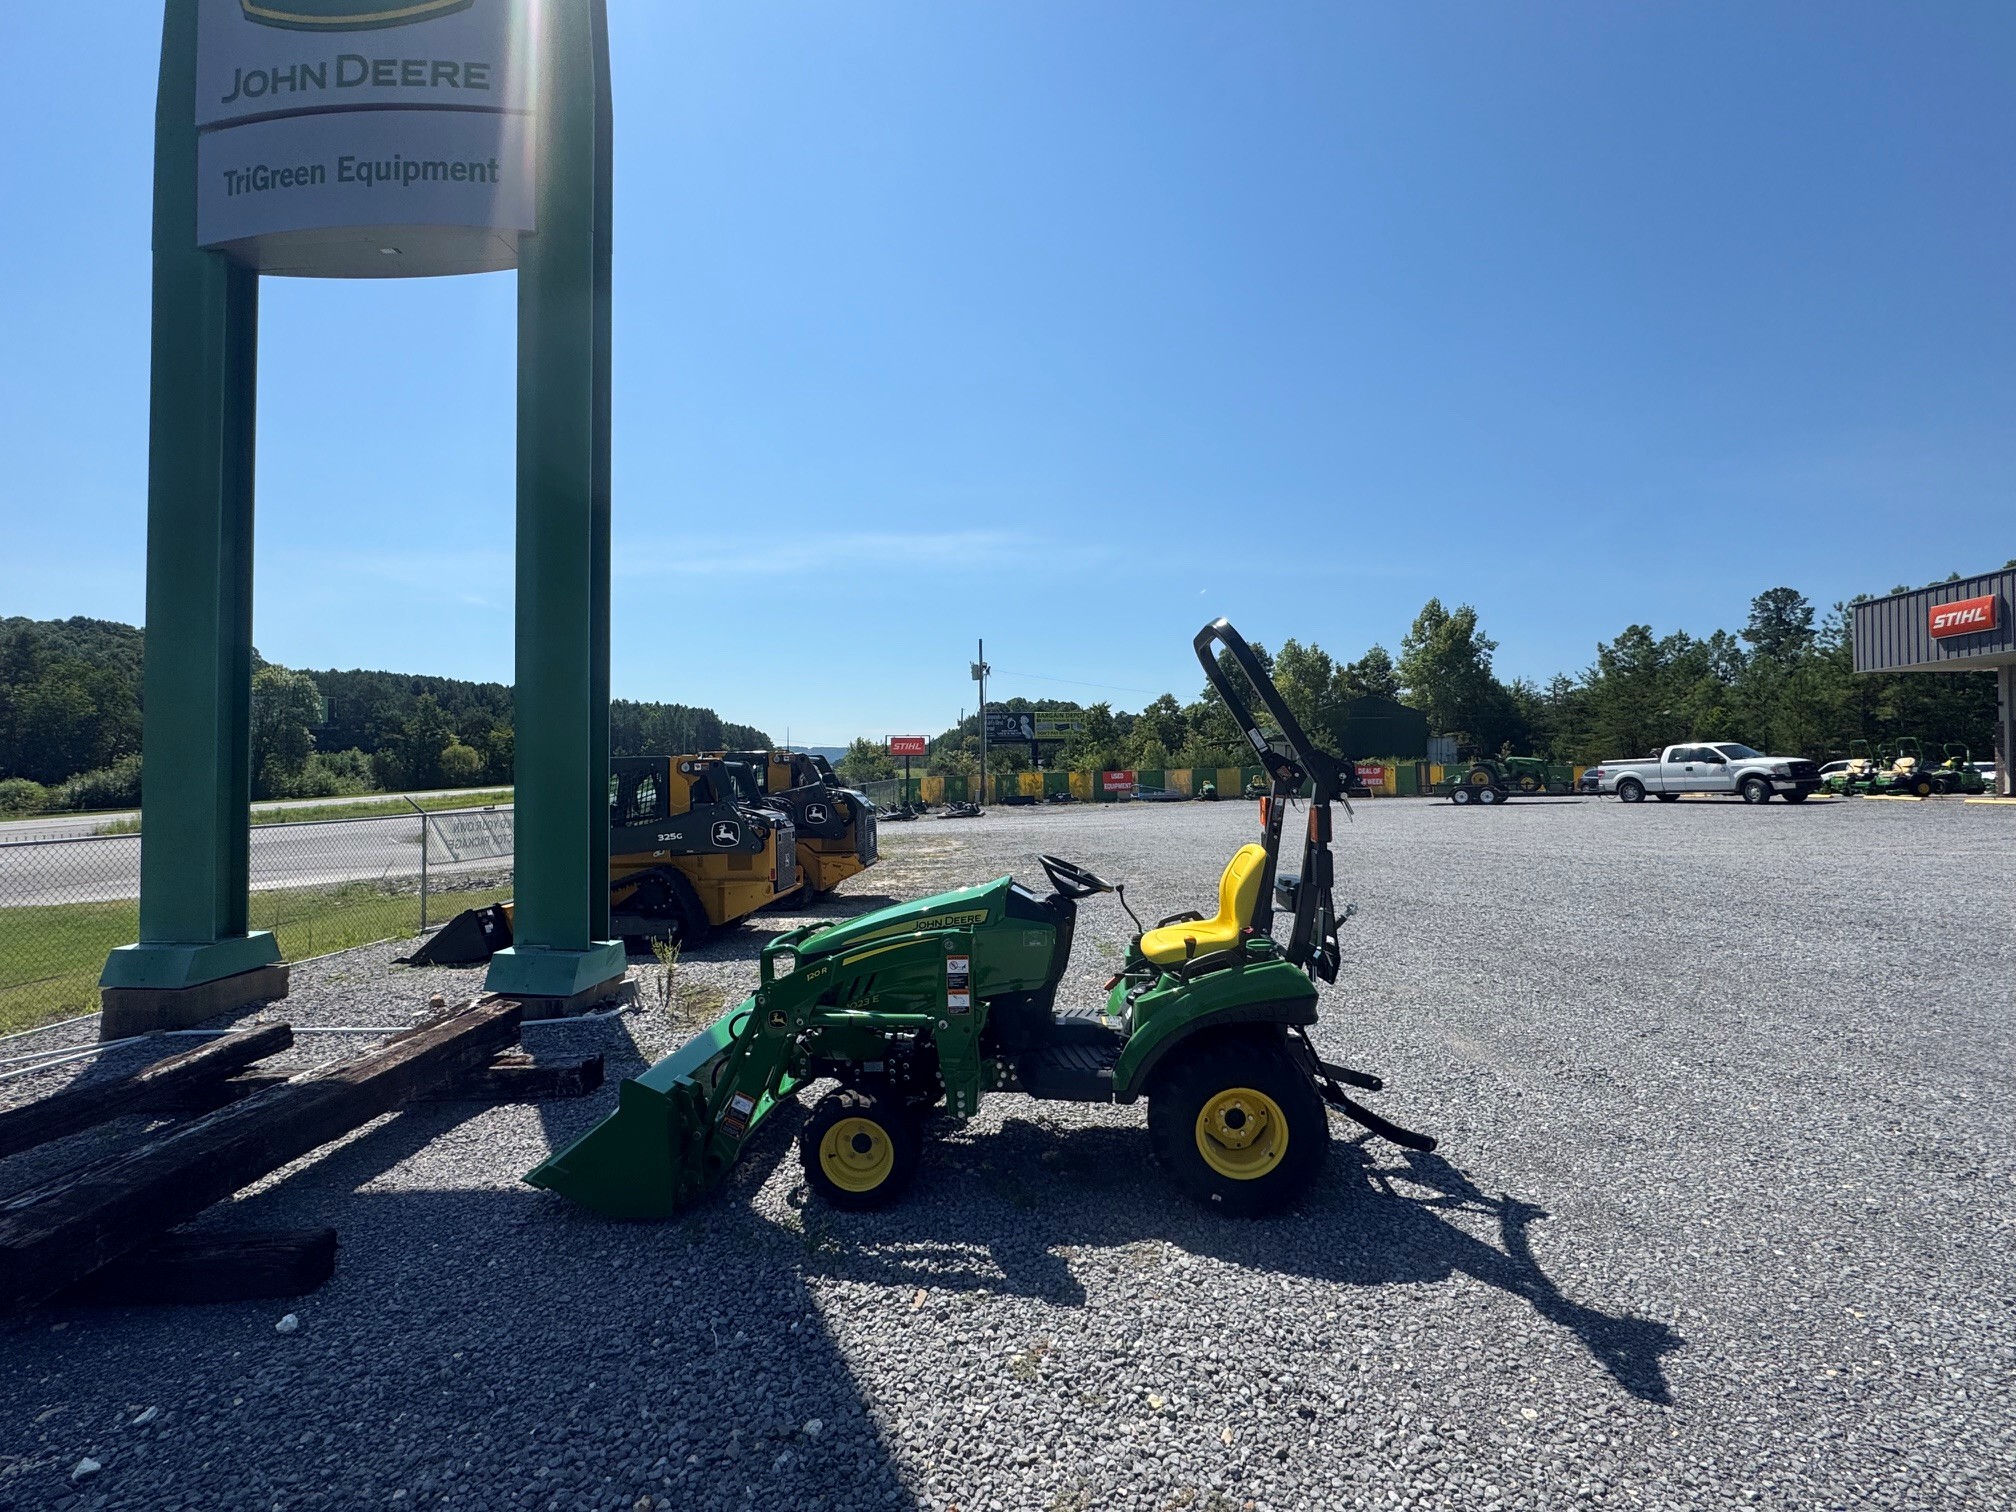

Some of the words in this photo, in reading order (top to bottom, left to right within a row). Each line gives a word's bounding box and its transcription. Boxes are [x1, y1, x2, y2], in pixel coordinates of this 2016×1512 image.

[221, 61, 327, 104] JOHN
[336, 53, 491, 91] DEERE
[223, 164, 326, 197] TriGreen
[337, 154, 500, 188] Equipment
[1933, 607, 1987, 629] STIHL
[893, 742, 922, 750] STIHL
[1104, 782, 1132, 790] EQUIPMENT
[657, 832, 683, 841] 325G
[912, 918, 943, 931] JOHN
[945, 914, 982, 926] DEERE
